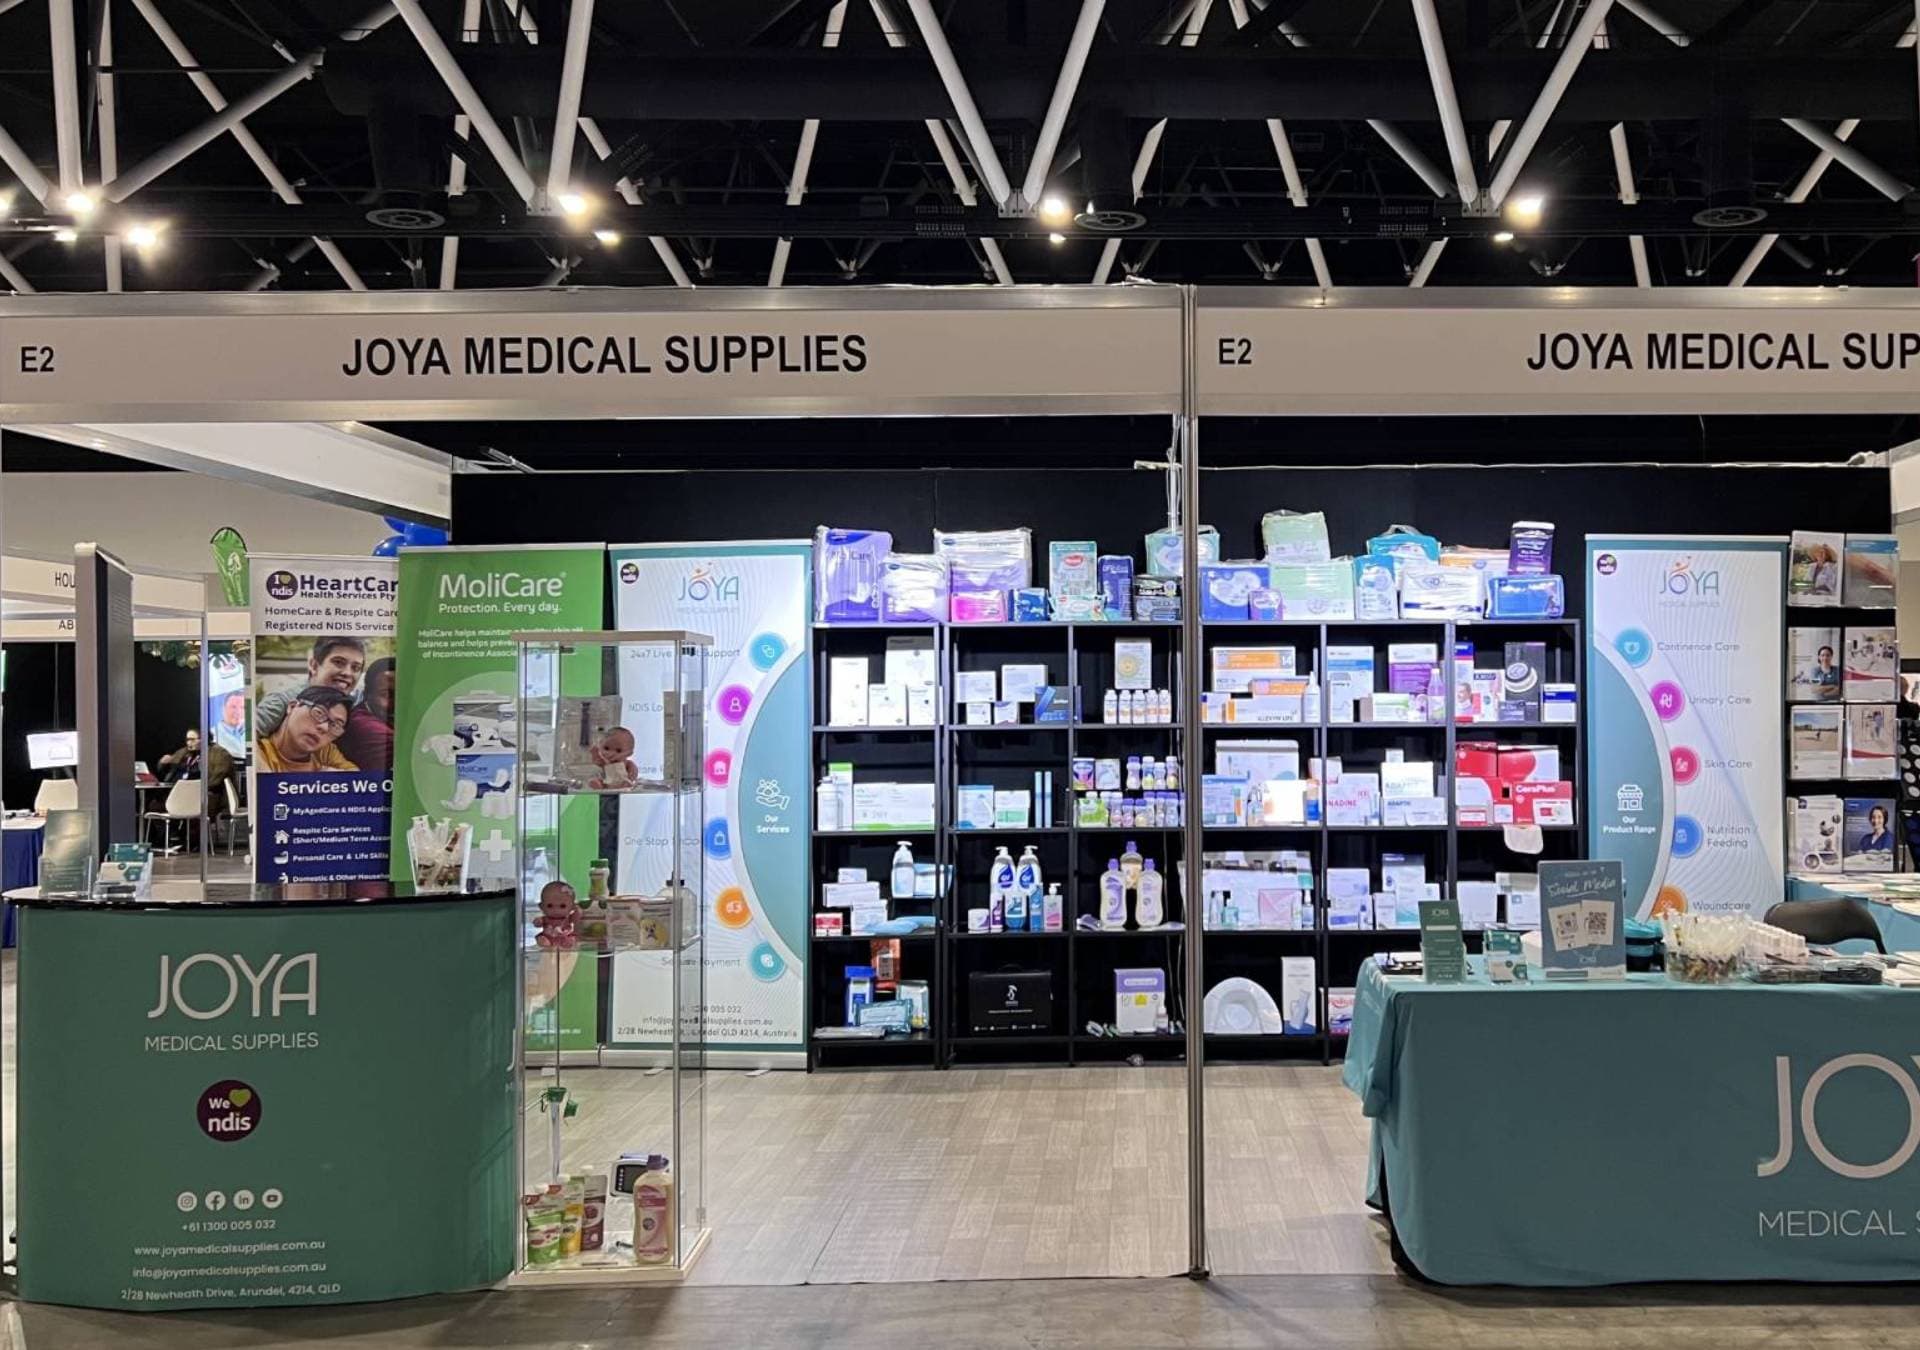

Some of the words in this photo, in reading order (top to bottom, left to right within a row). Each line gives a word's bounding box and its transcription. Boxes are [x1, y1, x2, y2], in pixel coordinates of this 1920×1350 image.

[342, 338, 450, 377] JOYA
[464, 336, 650, 375] MEDICAL
[664, 335, 867, 373] SUPPLIES
[1218, 338, 1252, 365] E2
[1526, 333, 1632, 370] JOYA
[1647, 333, 1829, 369] MEDICAL
[1843, 332, 1920, 370] SUP
[20, 346, 54, 373] E2
[678, 575, 740, 602] JOYA
[1660, 570, 1720, 596] JOYA
[271, 586, 294, 596] ndis
[301, 591, 334, 599] Health
[336, 592, 378, 600] Services
[380, 592, 396, 601] Pty
[265, 606, 322, 616] HomeCare
[324, 607, 332, 616] &
[334, 607, 374, 618] Respite
[438, 602, 501, 614] Protection.
[503, 601, 536, 615] Every
[537, 601, 562, 614] day.
[265, 620, 323, 632] Registered
[326, 621, 353, 631] NDIS
[355, 622, 394, 631] Service
[454, 628, 475, 638] helps
[417, 640, 449, 648] balance
[450, 640, 465, 648] and
[466, 640, 488, 648] helps
[1657, 641, 1713, 651] Continence
[1715, 642, 1740, 651] Care
[653, 649, 672, 657] Live
[1688, 695, 1724, 706] Urinary
[1727, 695, 1752, 705] Care
[1704, 759, 1726, 769] Skin
[1727, 759, 1753, 769] Care
[277, 780, 349, 794] Services
[352, 779, 378, 793] We
[764, 814, 779, 823] Our
[1622, 815, 1637, 824] Our
[292, 827, 321, 835] Respite
[756, 824, 791, 834] Services
[1603, 825, 1633, 834] Product
[1634, 825, 1657, 834] Range
[1707, 825, 1751, 835] Nutrition
[624, 836, 642, 846] One
[643, 836, 669, 848] Stop
[1707, 838, 1750, 849] Feeding
[292, 854, 325, 862] Personal
[354, 852, 369, 860] Life
[1692, 901, 1751, 911] Woundcare
[148, 952, 318, 1020] JOYA
[145, 1035, 226, 1052] MEDICAL
[231, 1032, 320, 1050] SUPPLIES
[208, 1097, 231, 1110] We
[1757, 1053, 1920, 1179] JO
[208, 1112, 252, 1133] ndis
[181, 1222, 201, 1233] +61
[202, 1221, 228, 1232] 1300
[230, 1220, 253, 1231] 005
[255, 1219, 277, 1230] 032
[1759, 1209, 1907, 1237] MEDICAL
[134, 1240, 326, 1258] www.joyamedicalsupplies.com.au
[132, 1262, 327, 1280] info@joyamedicalsupplies.com.au
[121, 1289, 144, 1301] 2/28
[145, 1288, 204, 1301] Newheath
[317, 1283, 342, 1295] QLD
